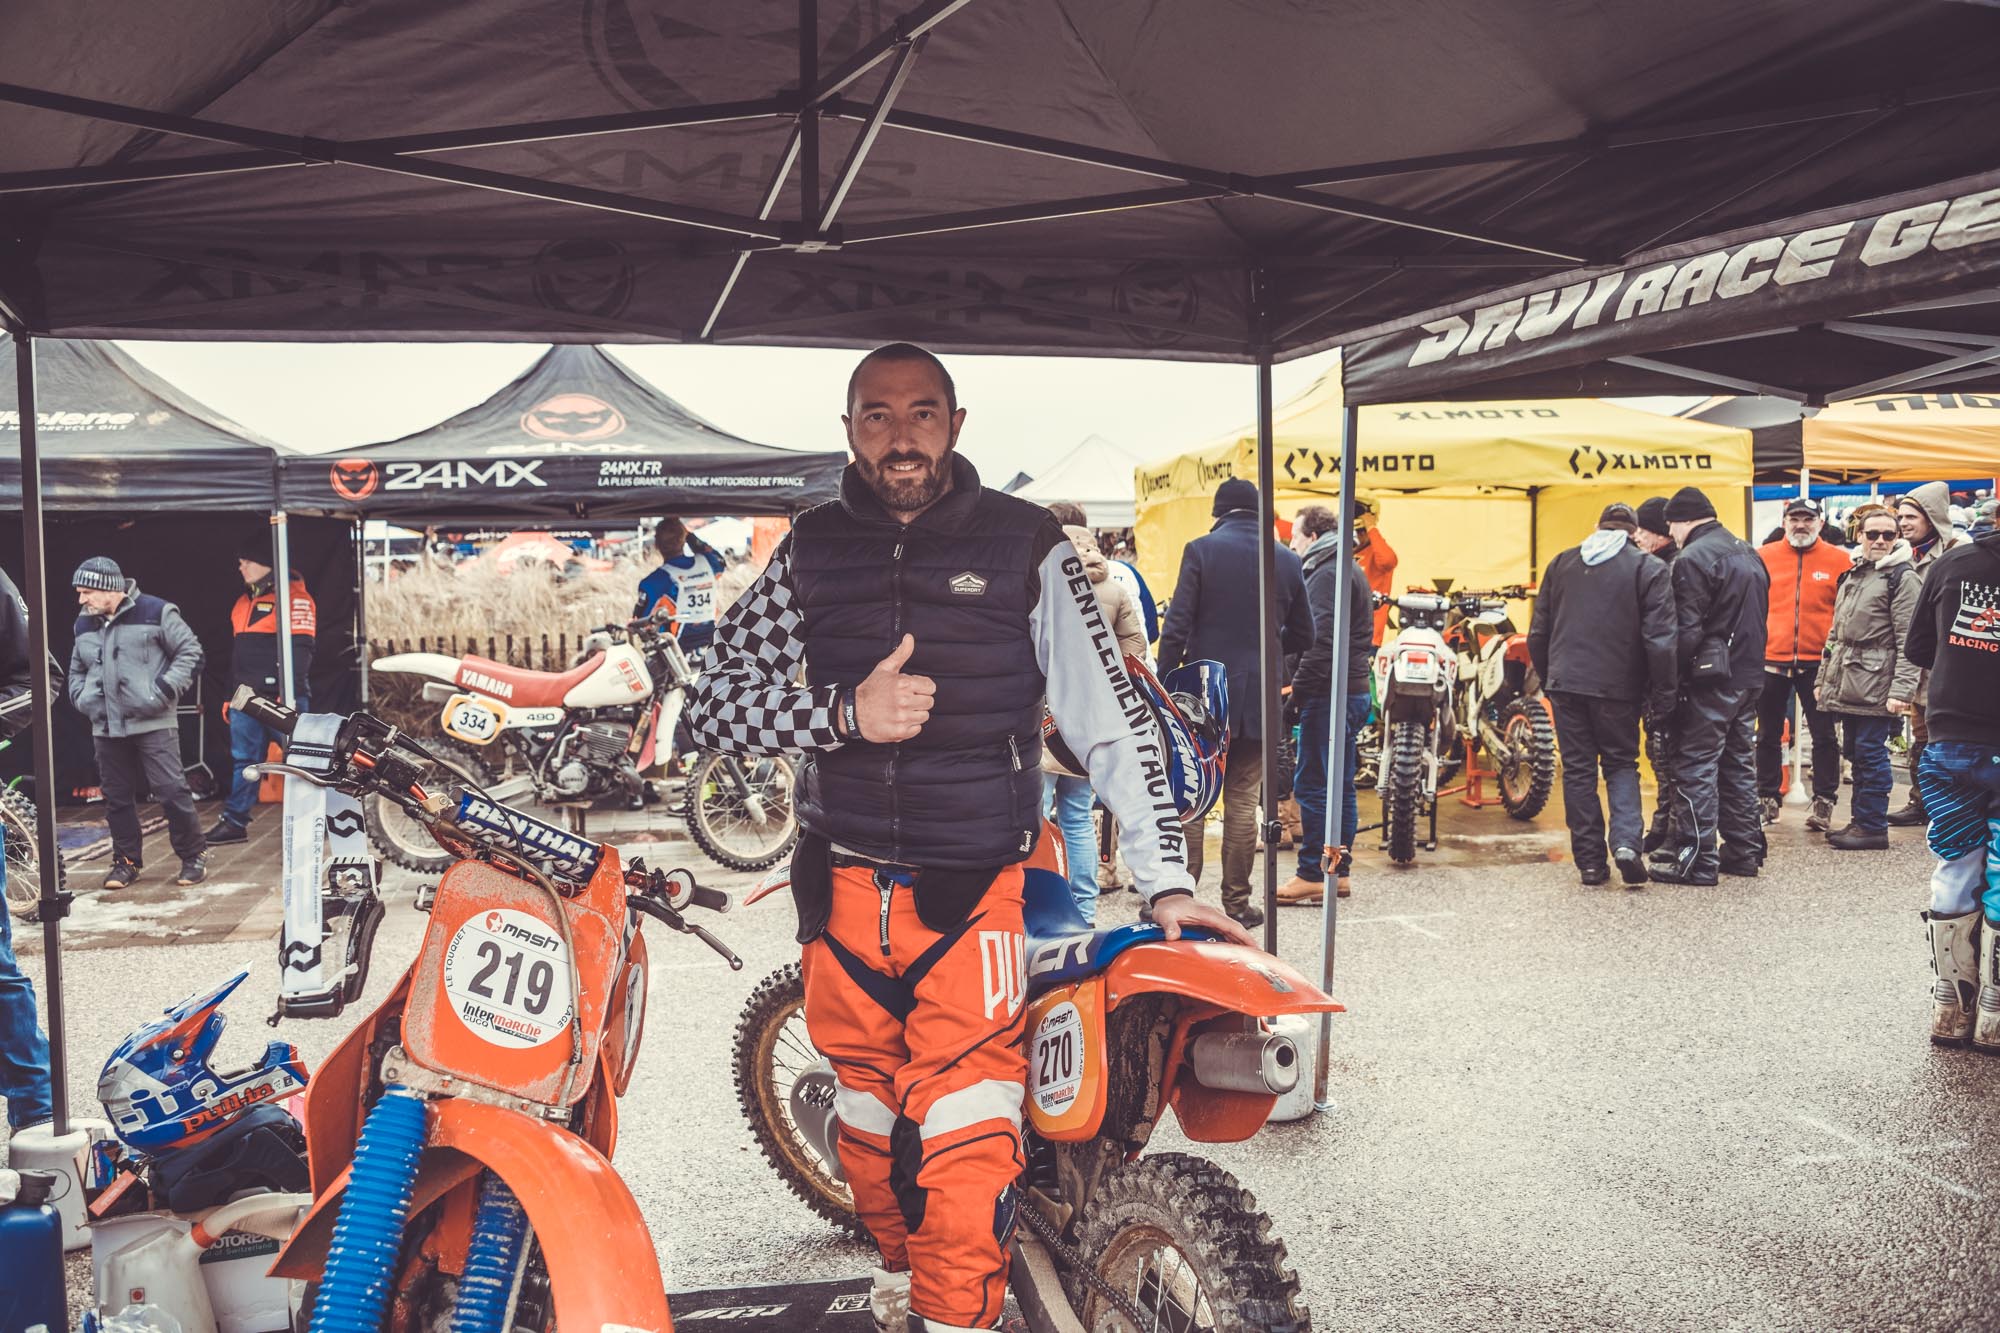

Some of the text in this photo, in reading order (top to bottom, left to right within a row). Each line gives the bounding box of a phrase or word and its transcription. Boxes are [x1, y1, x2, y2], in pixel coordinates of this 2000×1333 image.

[1615, 221, 1856, 321] RACE
[1394, 408, 1560, 421] XLMOTO
[600, 461, 662, 475] 24MX.FR
[1328, 455, 1435, 472] XMOTO
[1611, 454, 1712, 470] XLMOTO
[385, 460, 548, 490] 24MX
[598, 477, 805, 486] LA PLUS GRANDE BOUTIQUE MOTOCROSS DE FRANCE
[687, 593, 711, 608] 334
[1949, 634, 1999, 653] RACING
[460, 669, 513, 698] YAMAHA
[460, 711, 487, 731] 334
[526, 713, 555, 721] 490
[1159, 706, 1200, 809] KENNY
[465, 799, 596, 866] RENTHAL
[446, 928, 466, 988] LE TOUQUET
[467, 940, 554, 1015] 219
[463, 1014, 489, 1028] CUCQ
[1039, 1030, 1072, 1087] 270
[181, 1082, 277, 1135] pull-in
